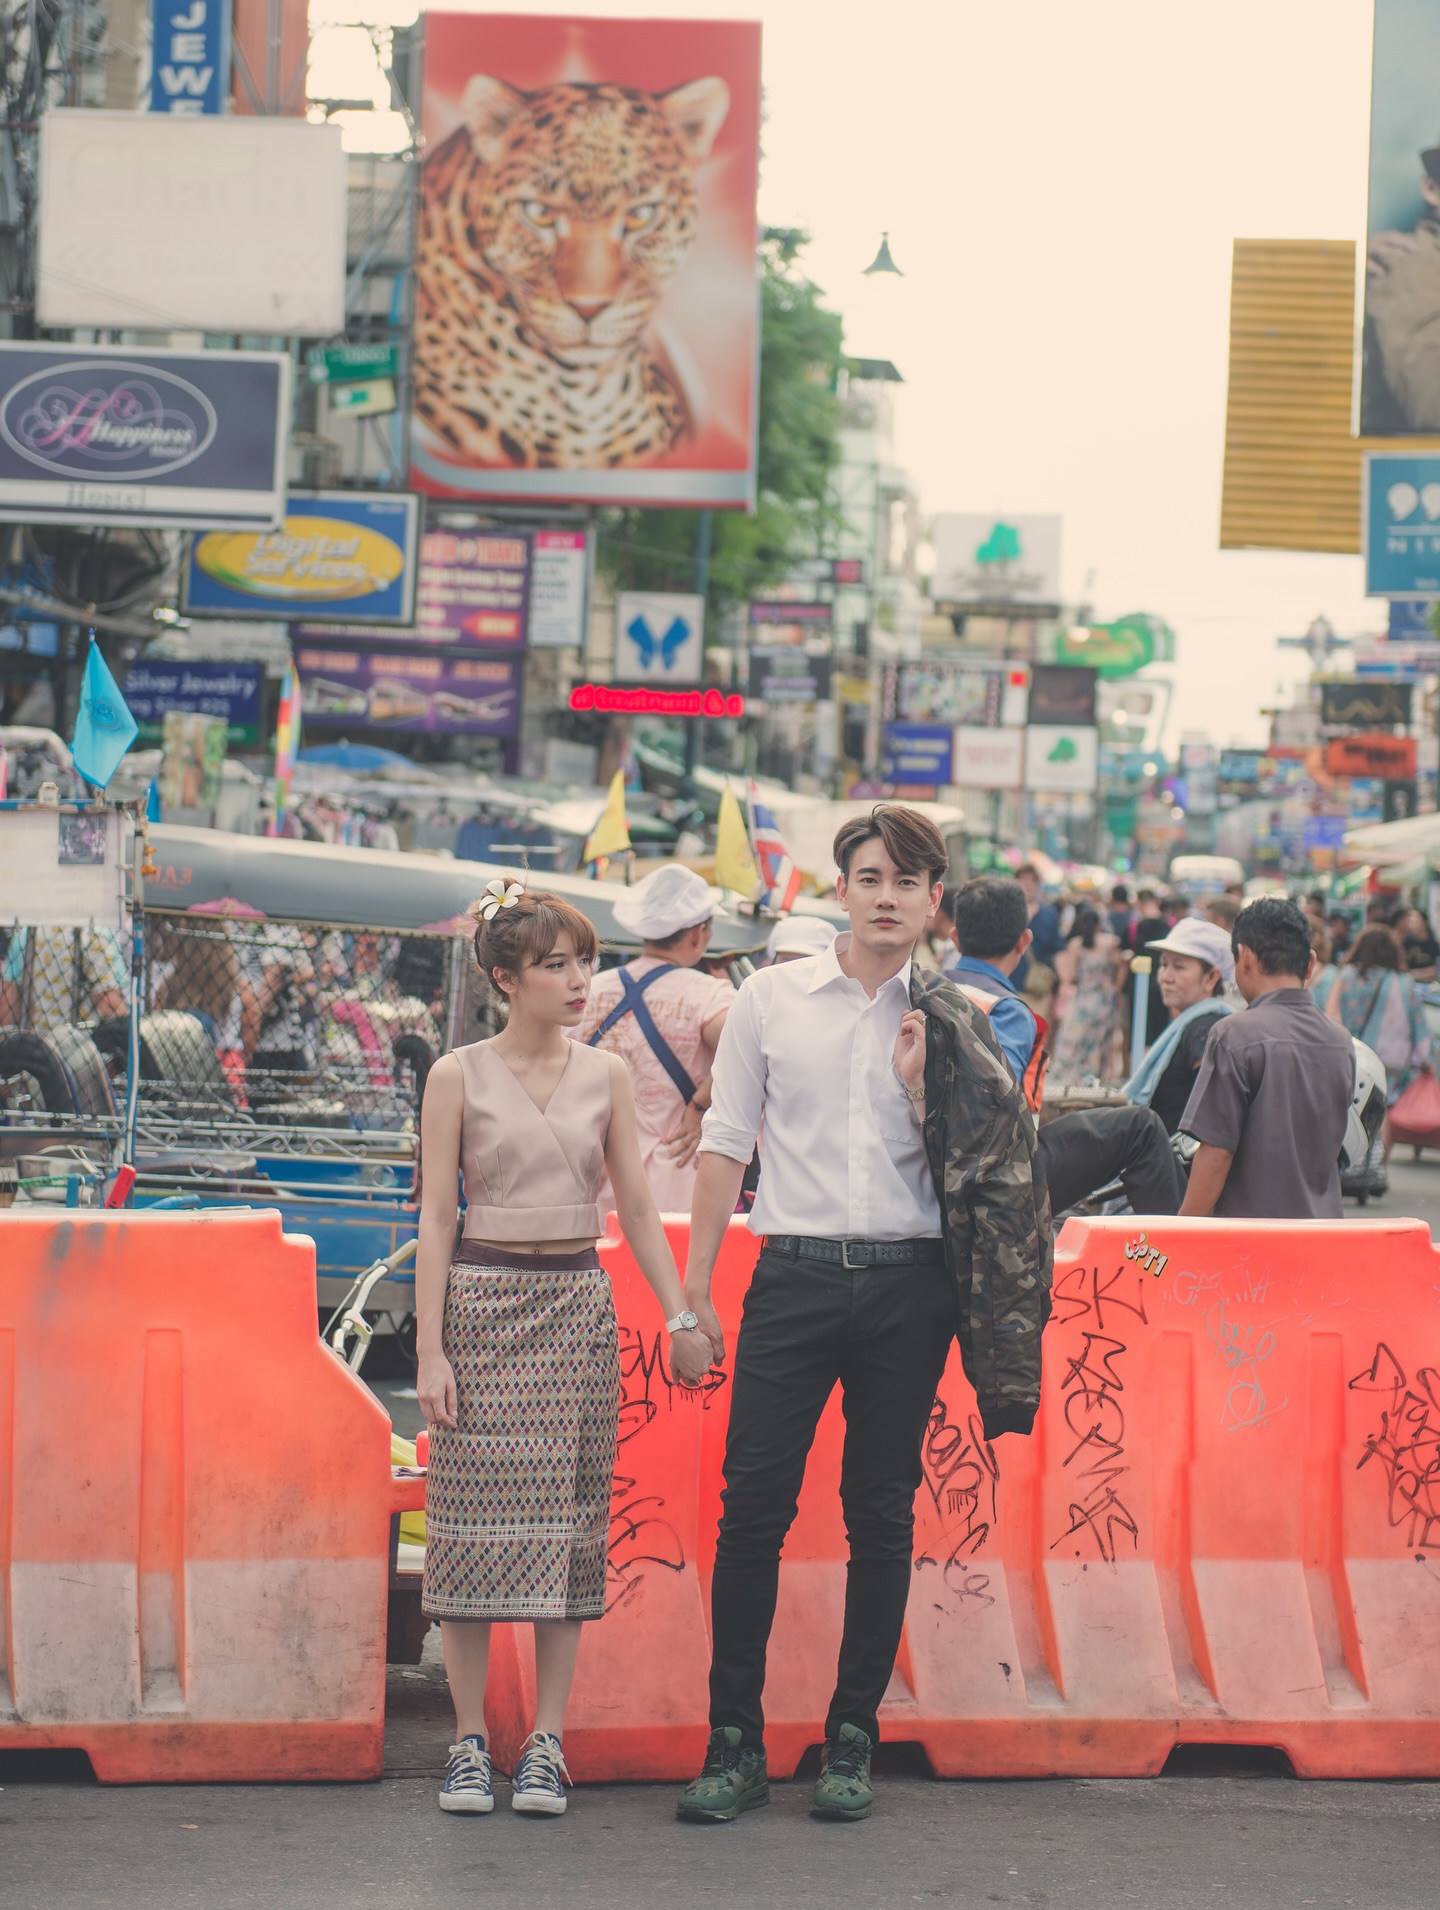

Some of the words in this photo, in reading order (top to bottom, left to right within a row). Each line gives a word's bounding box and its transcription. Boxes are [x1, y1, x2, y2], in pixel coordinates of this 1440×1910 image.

[89, 420, 193, 448] Happiness
[67, 483, 147, 511] Hostel
[251, 530, 360, 561] Digital
[243, 554, 368, 584] Services
[125, 669, 179, 693] Silver
[180, 671, 257, 700] Jewelry
